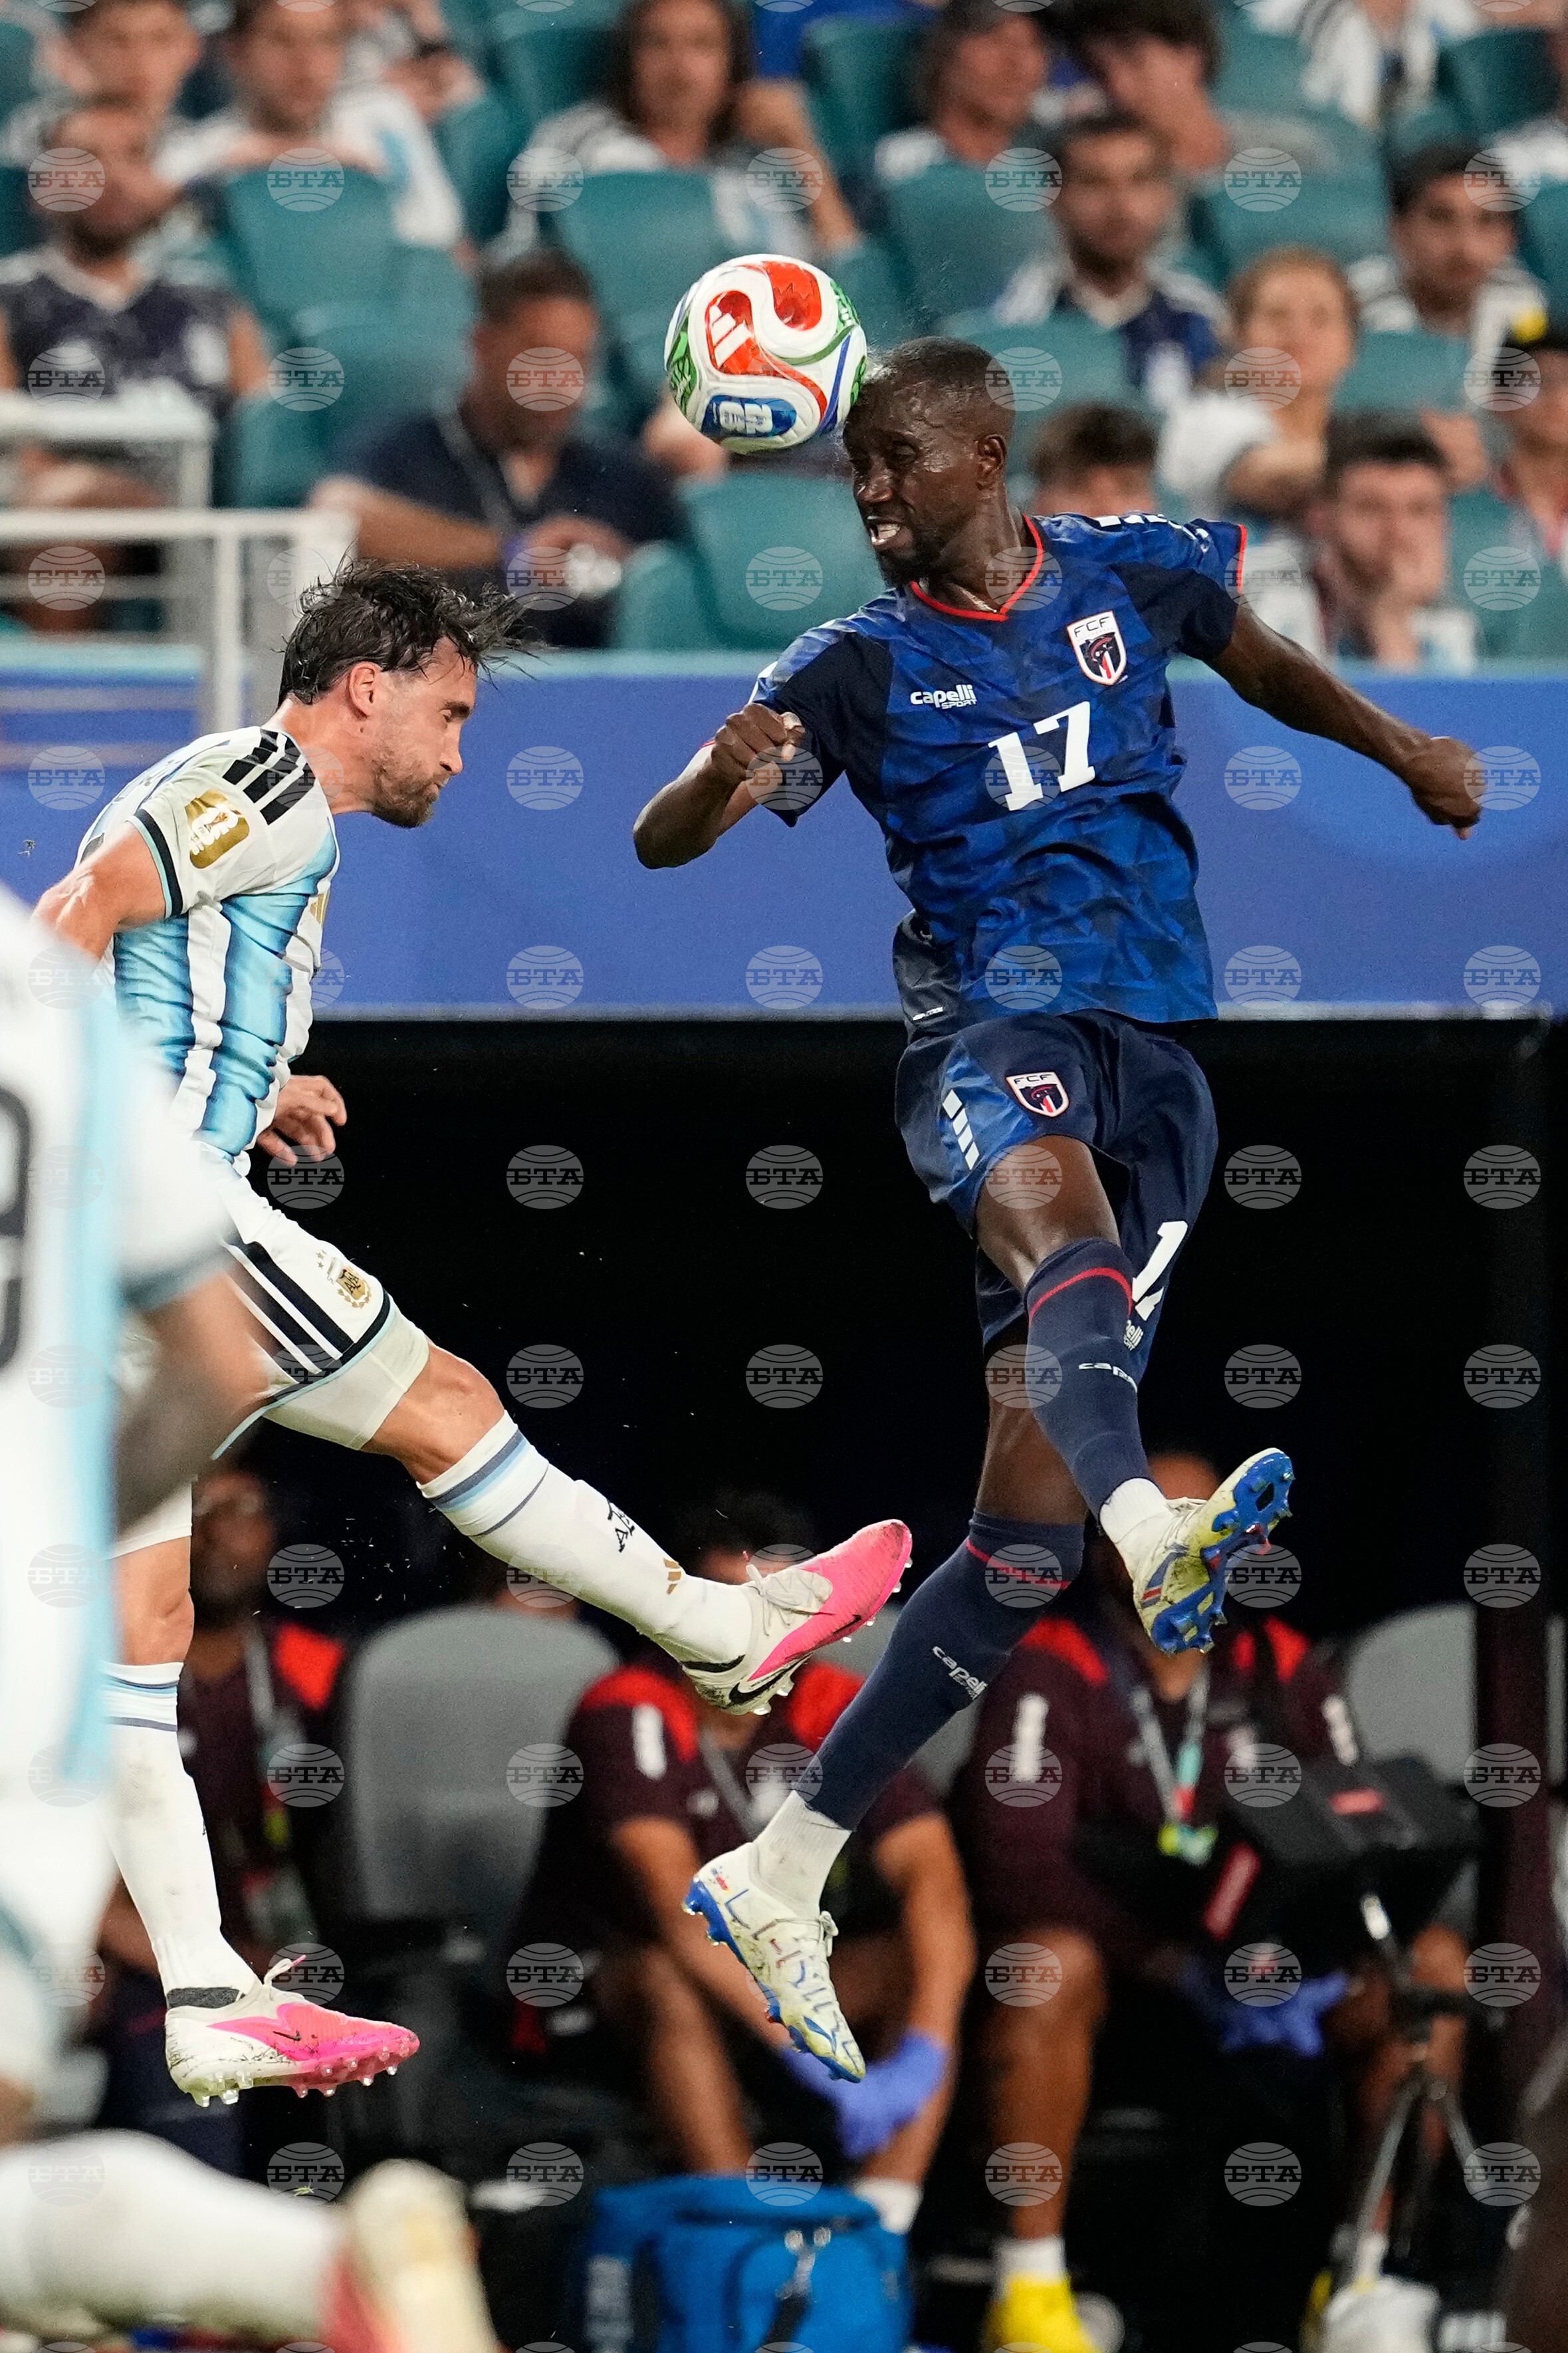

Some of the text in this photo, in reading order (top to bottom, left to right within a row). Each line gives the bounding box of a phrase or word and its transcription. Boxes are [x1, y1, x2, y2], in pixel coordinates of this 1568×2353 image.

[1073, 616, 1109, 637] FCF
[910, 684, 976, 708] capelli
[941, 699, 977, 709] SPORT
[988, 701, 1095, 811] 17
[1014, 1074, 1052, 1084] FCF
